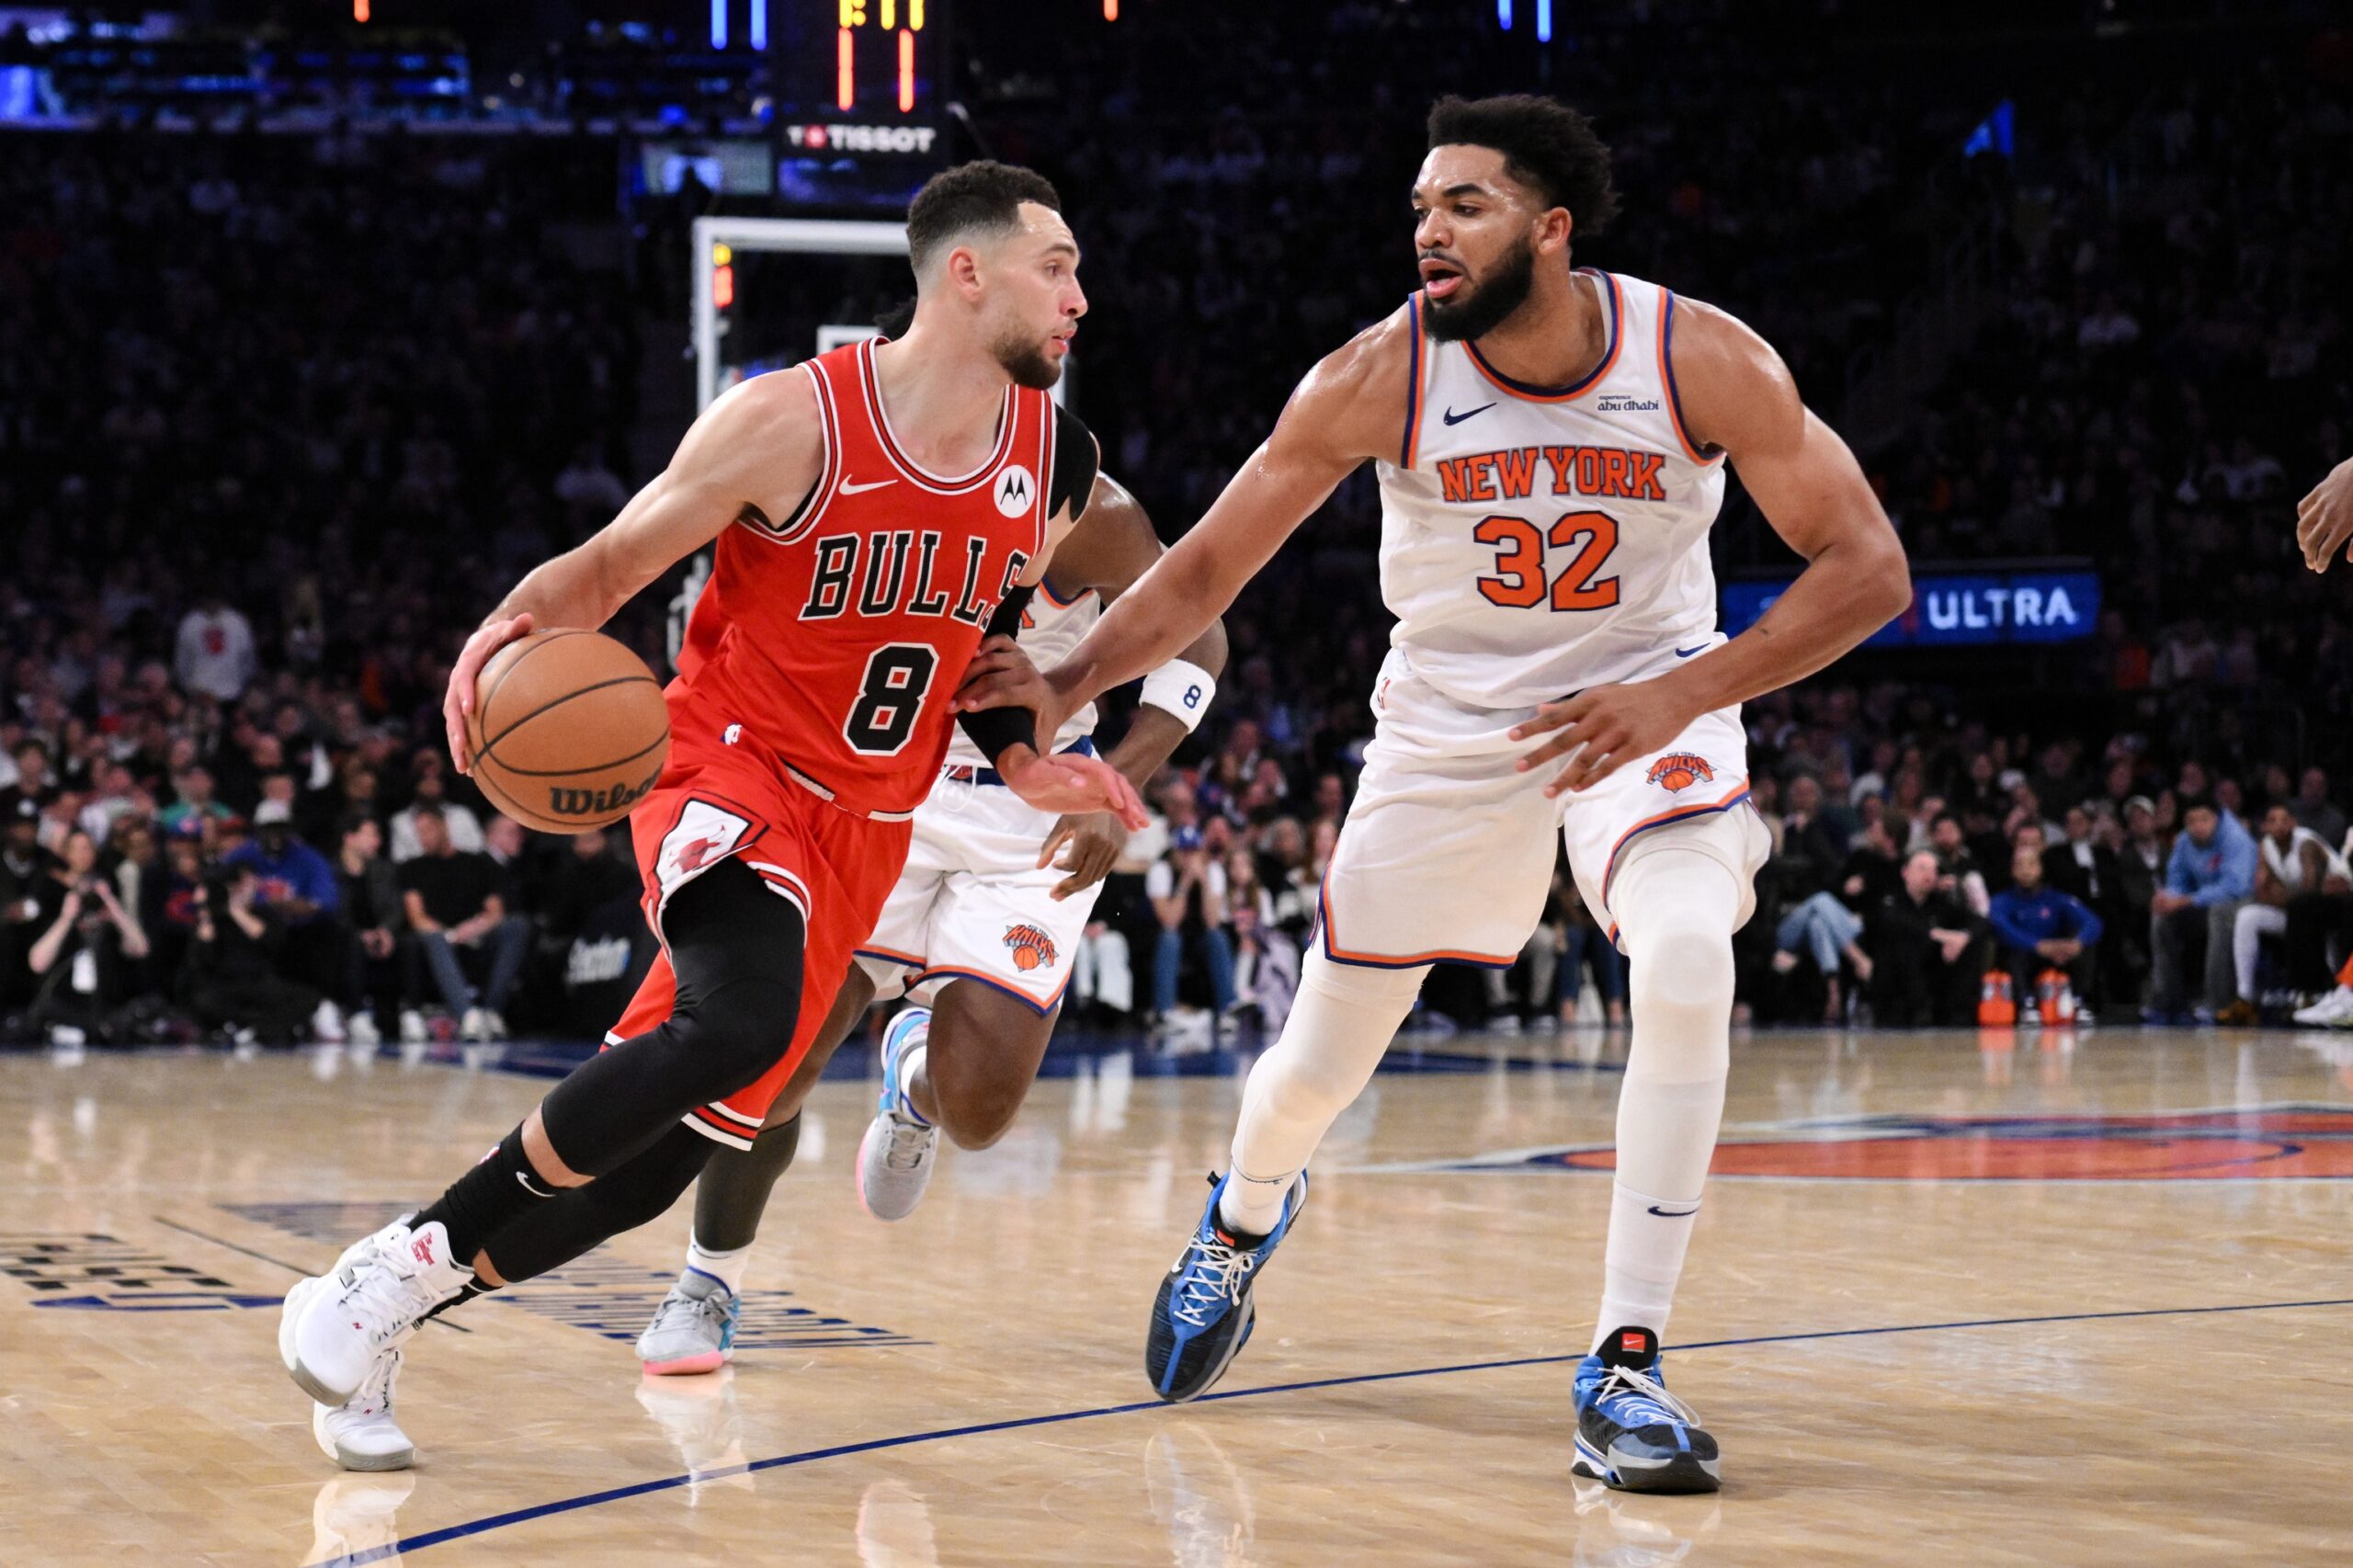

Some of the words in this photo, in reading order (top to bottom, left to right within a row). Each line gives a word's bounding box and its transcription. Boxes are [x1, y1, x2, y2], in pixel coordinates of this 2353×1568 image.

[827, 125, 936, 153] TISSOT
[1597, 401, 1621, 411] abu
[1623, 400, 1659, 411] dhabi
[1437, 446, 1540, 503] NEW
[1542, 445, 1667, 502] YORK
[1473, 510, 1620, 612] 32
[1927, 586, 2078, 630] ULTRA
[843, 642, 940, 756] 8
[1183, 684, 1202, 710] 8
[1002, 924, 1055, 968] KNICKS
